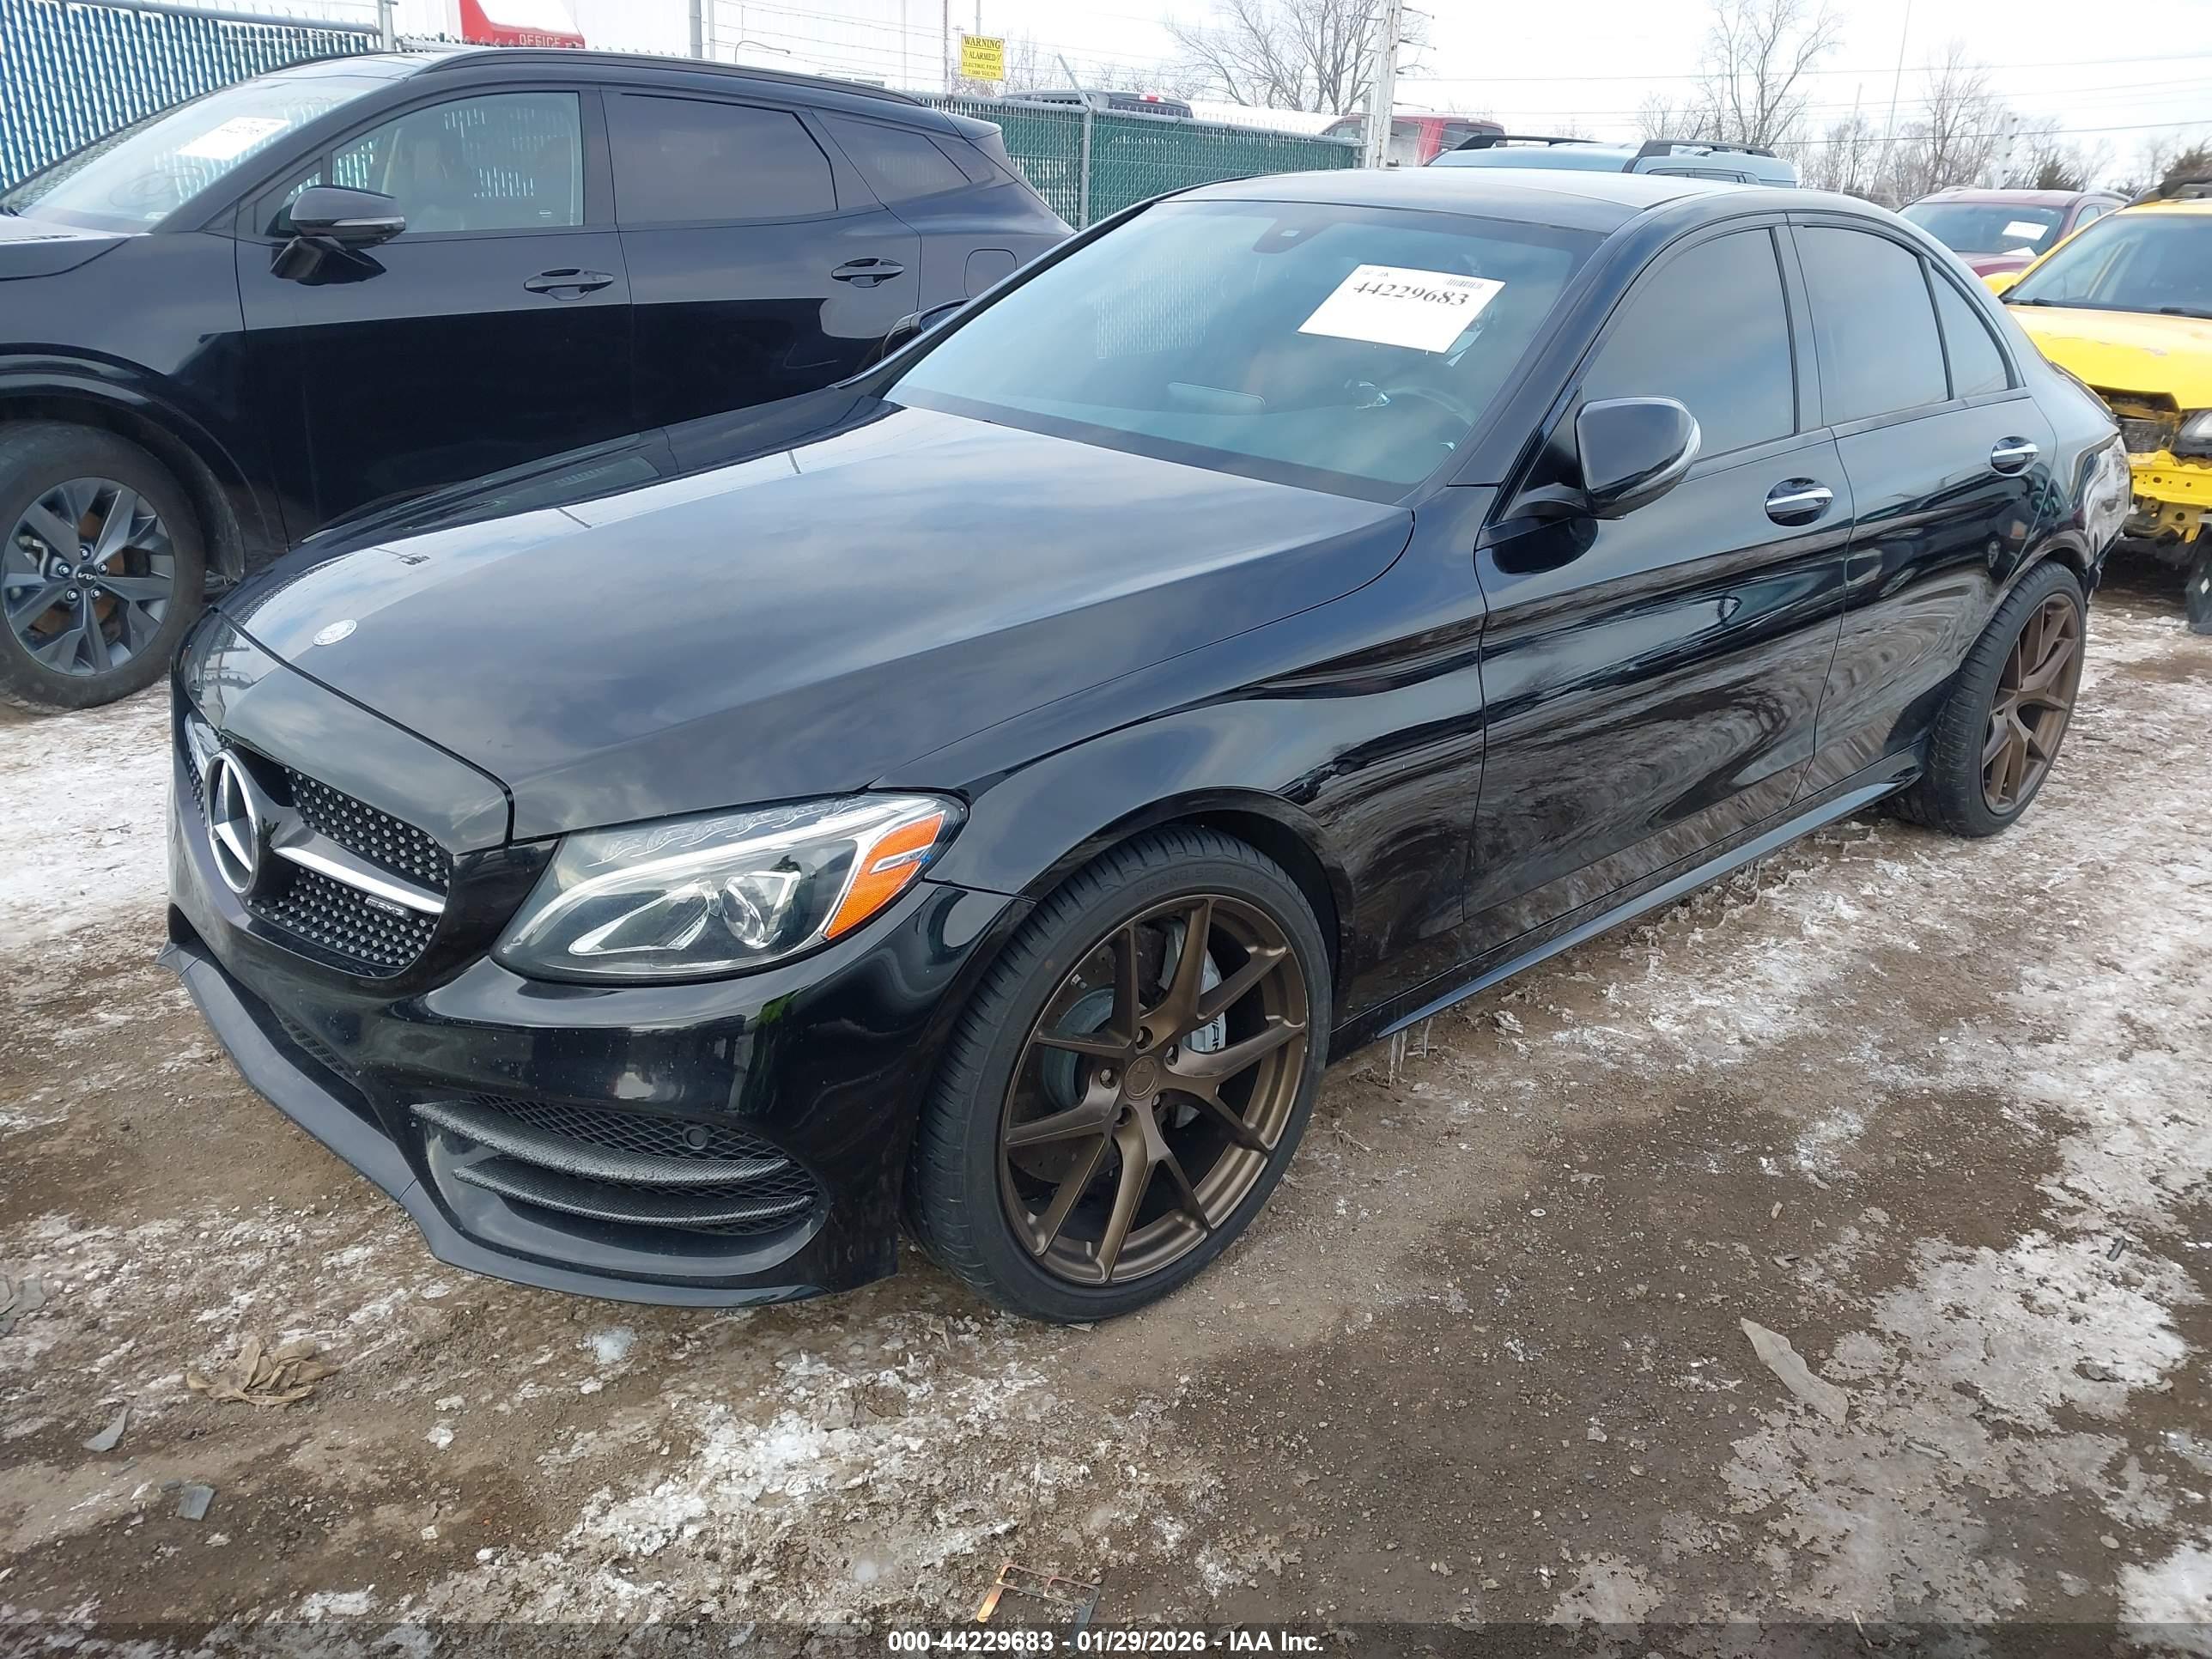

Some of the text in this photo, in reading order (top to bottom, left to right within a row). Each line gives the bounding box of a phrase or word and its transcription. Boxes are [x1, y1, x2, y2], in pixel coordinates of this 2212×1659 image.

[519, 33, 561, 47] OFFICE
[964, 36, 1001, 49] WARNING
[969, 52, 996, 61] ALARMED
[1353, 282, 1469, 306] 44229683
